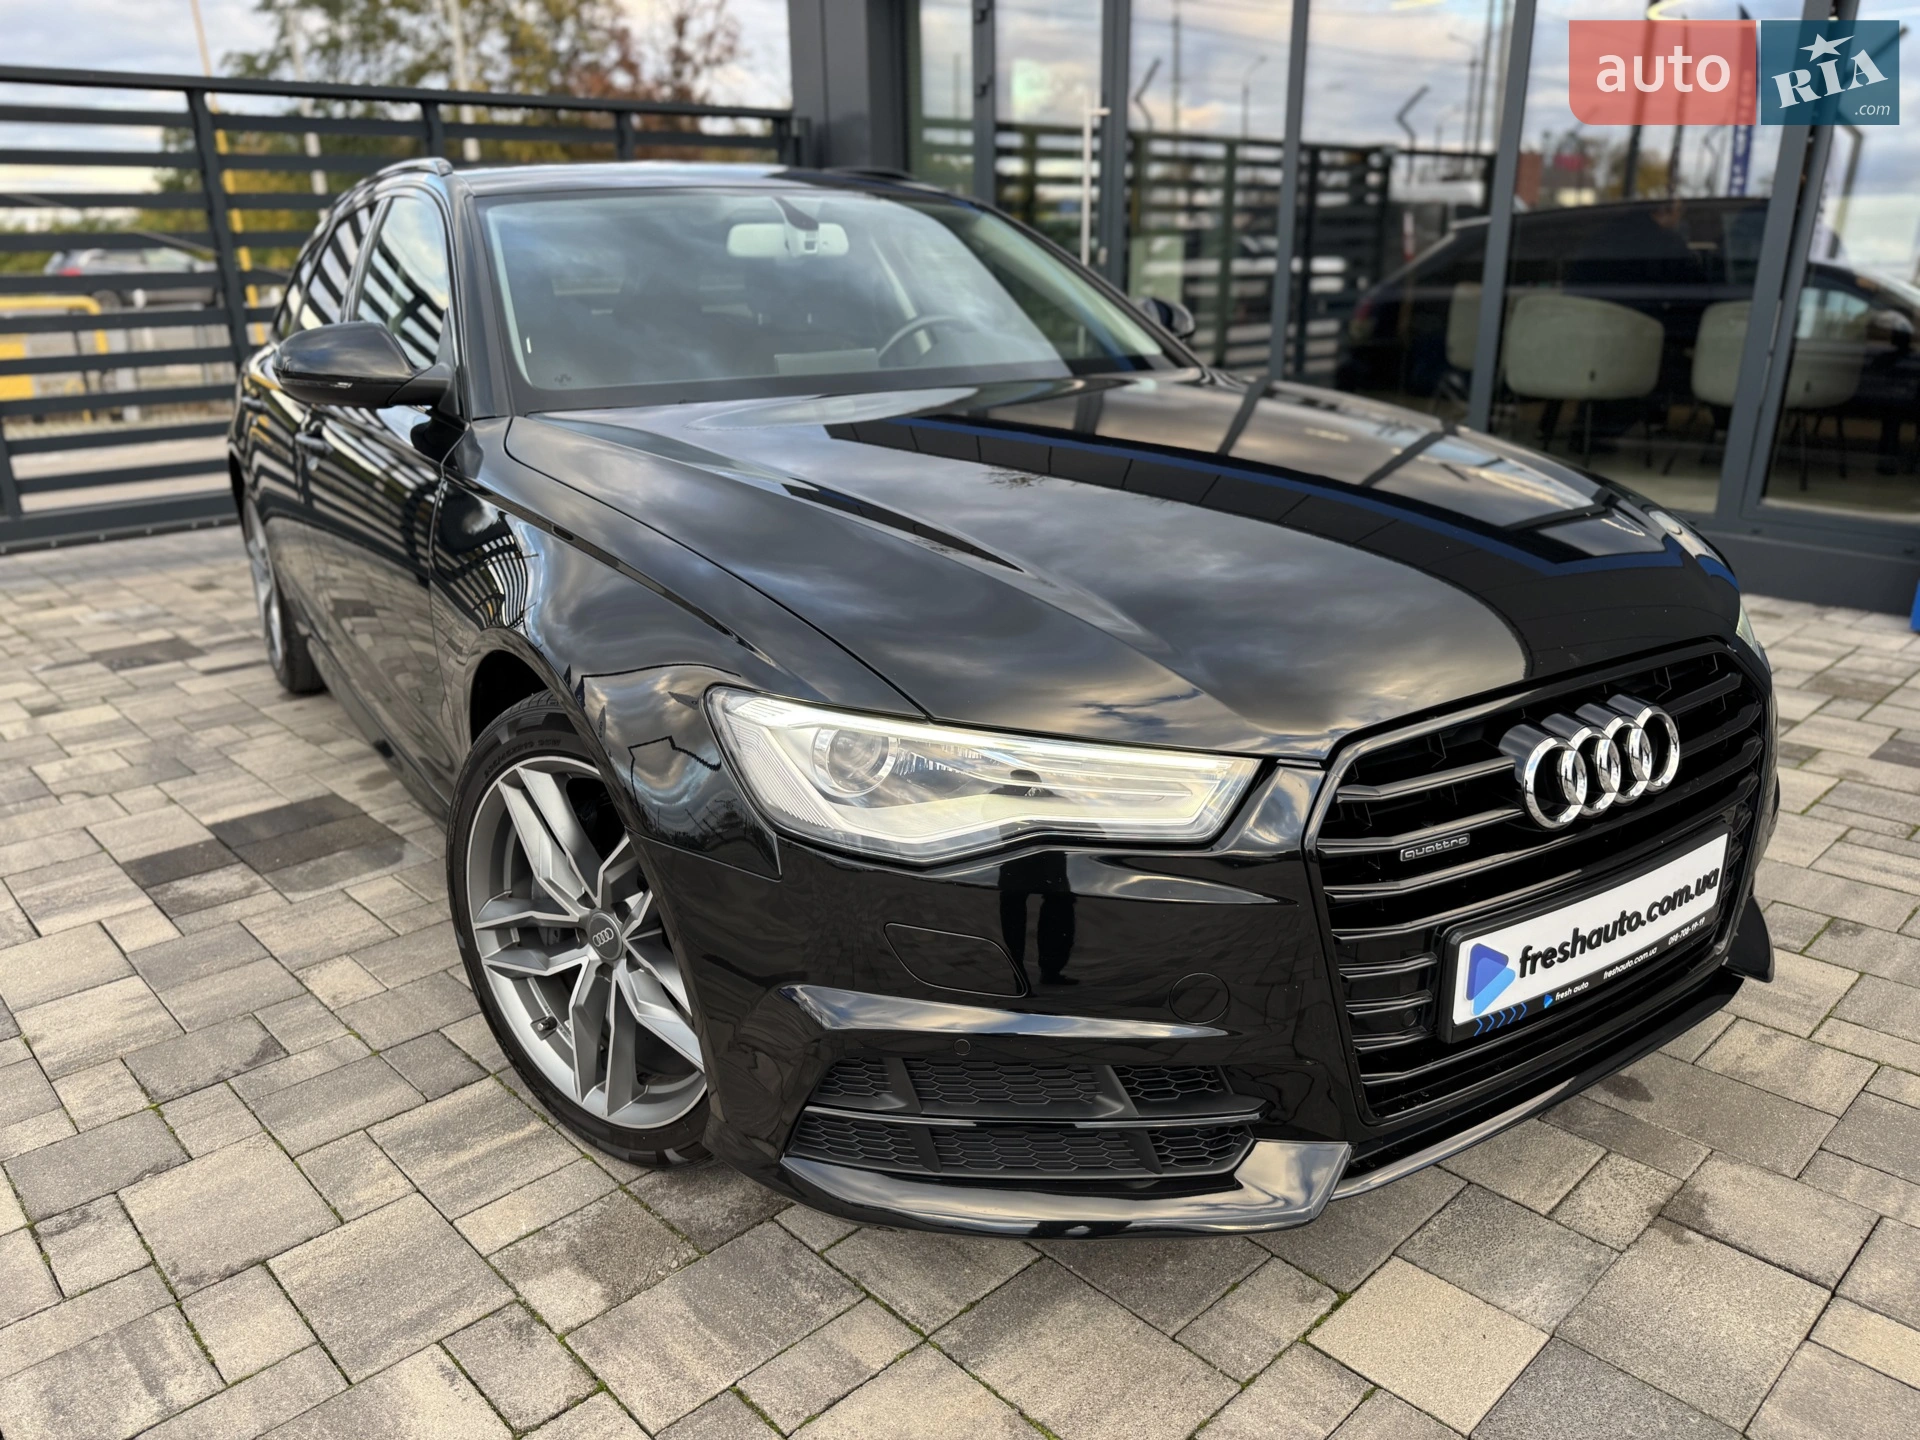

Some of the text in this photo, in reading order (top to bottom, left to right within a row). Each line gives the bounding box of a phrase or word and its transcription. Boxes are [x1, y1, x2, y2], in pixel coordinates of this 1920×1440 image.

[1404, 836, 1468, 859] quattro
[1519, 867, 1720, 978] freshauto.com.ua
[1555, 987, 1572, 1001] fresh
[1573, 981, 1589, 993] auto
[1603, 946, 1658, 980] freshauto.com.ua
